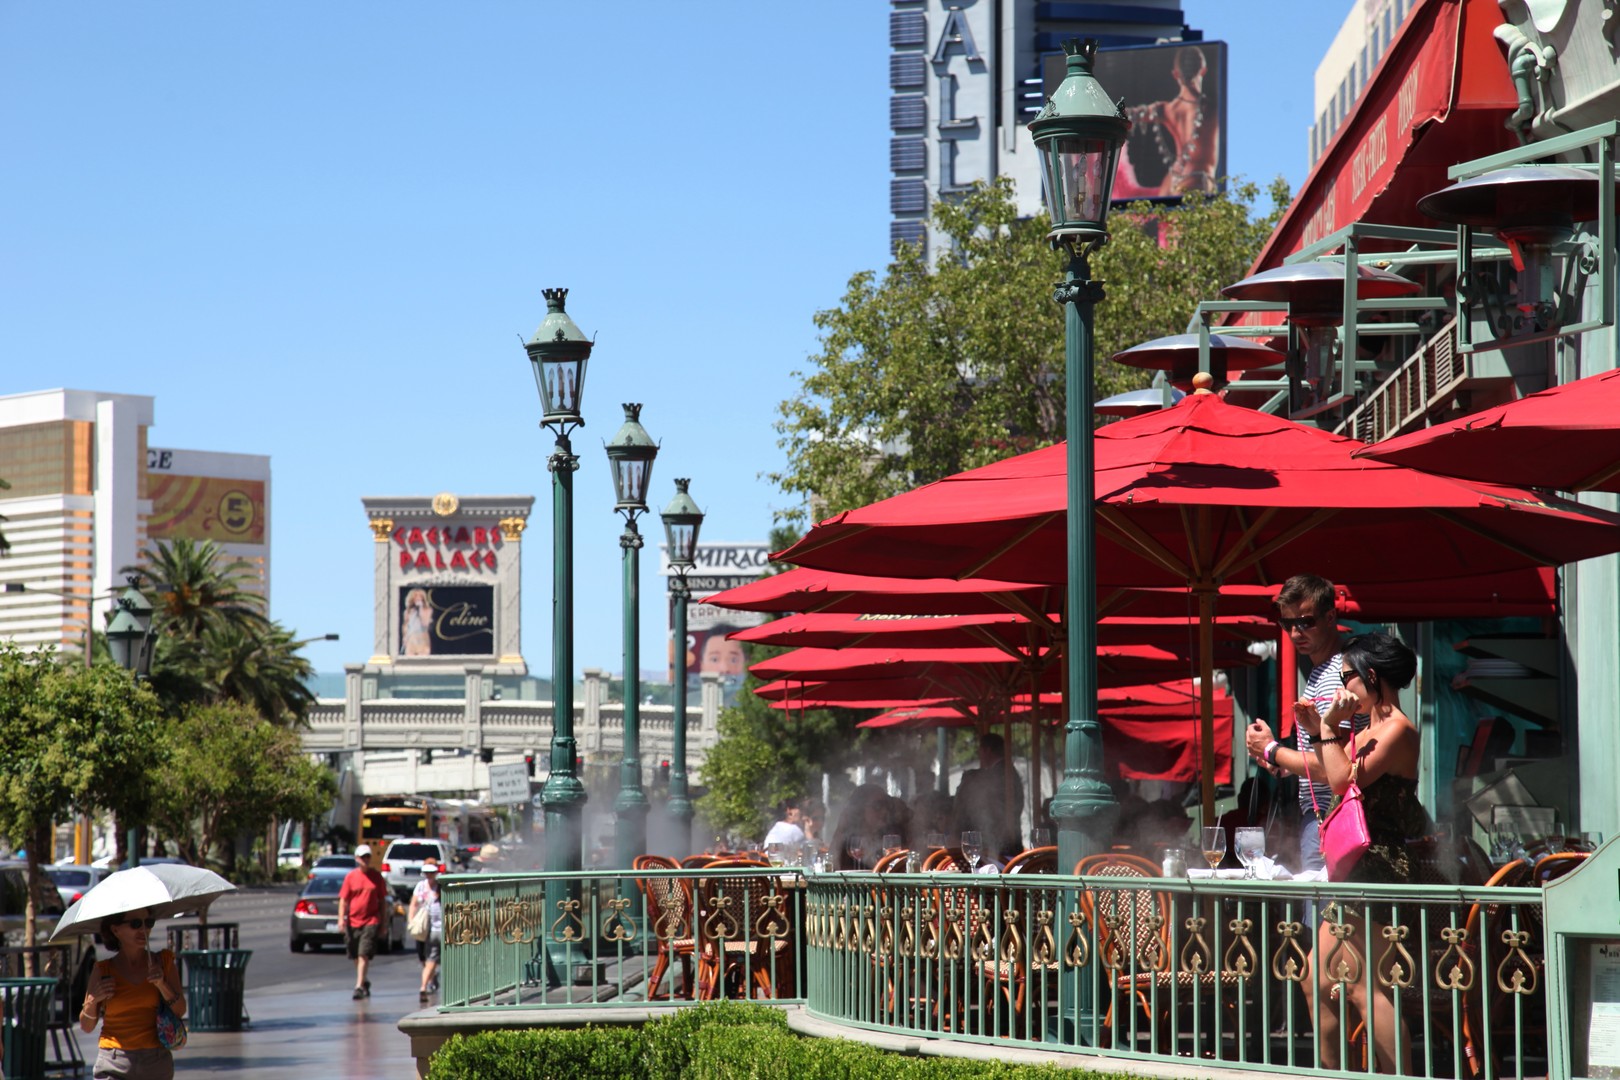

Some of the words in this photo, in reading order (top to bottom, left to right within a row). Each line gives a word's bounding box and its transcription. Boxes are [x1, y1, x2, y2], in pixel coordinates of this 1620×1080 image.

[393, 526, 502, 546] CAESARS
[399, 550, 497, 569] PALACE
[669, 578, 716, 589] CSINO
[434, 601, 493, 641] Celine
[497, 779, 521, 788] MUST
